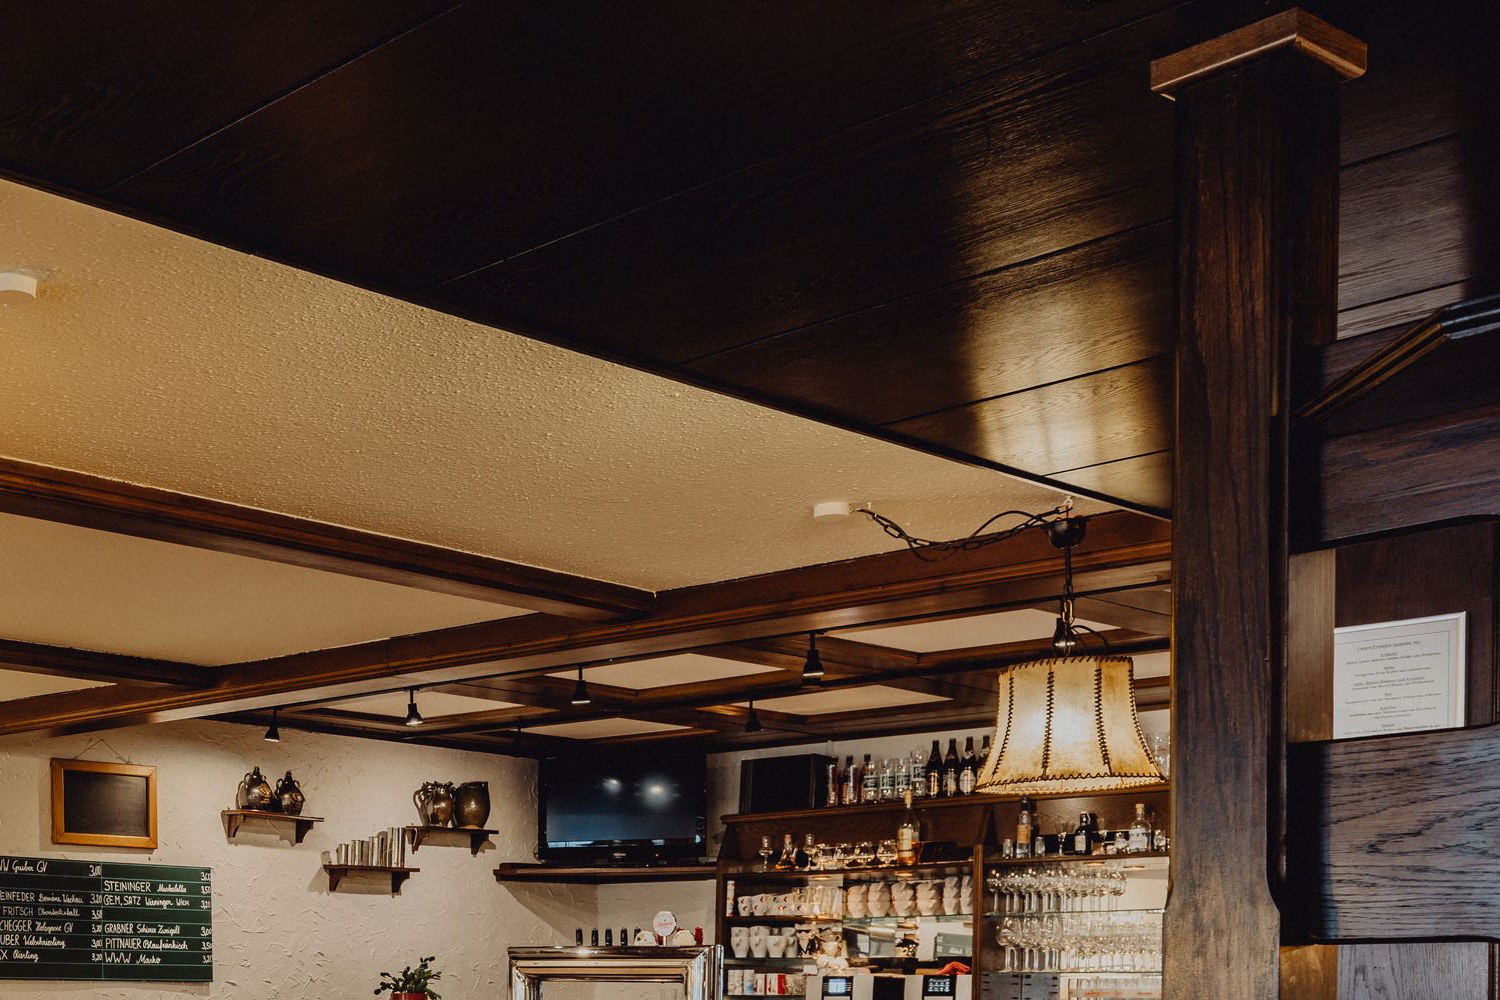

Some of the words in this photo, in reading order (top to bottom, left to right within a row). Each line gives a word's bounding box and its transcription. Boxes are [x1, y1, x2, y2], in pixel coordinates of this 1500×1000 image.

[12, 860, 34, 873] Gruber
[36, 860, 48, 873] GV
[104, 880, 151, 892] STEININGER
[3, 906, 34, 917] FRITSCH
[64, 922, 74, 933] GV
[104, 923, 134, 934] GRABNER
[22, 935, 66, 949] Welschriesling
[105, 938, 142, 949] PITTNAUER
[142, 939, 188, 951] Blaufränkisch
[104, 952, 132, 964] WWW
